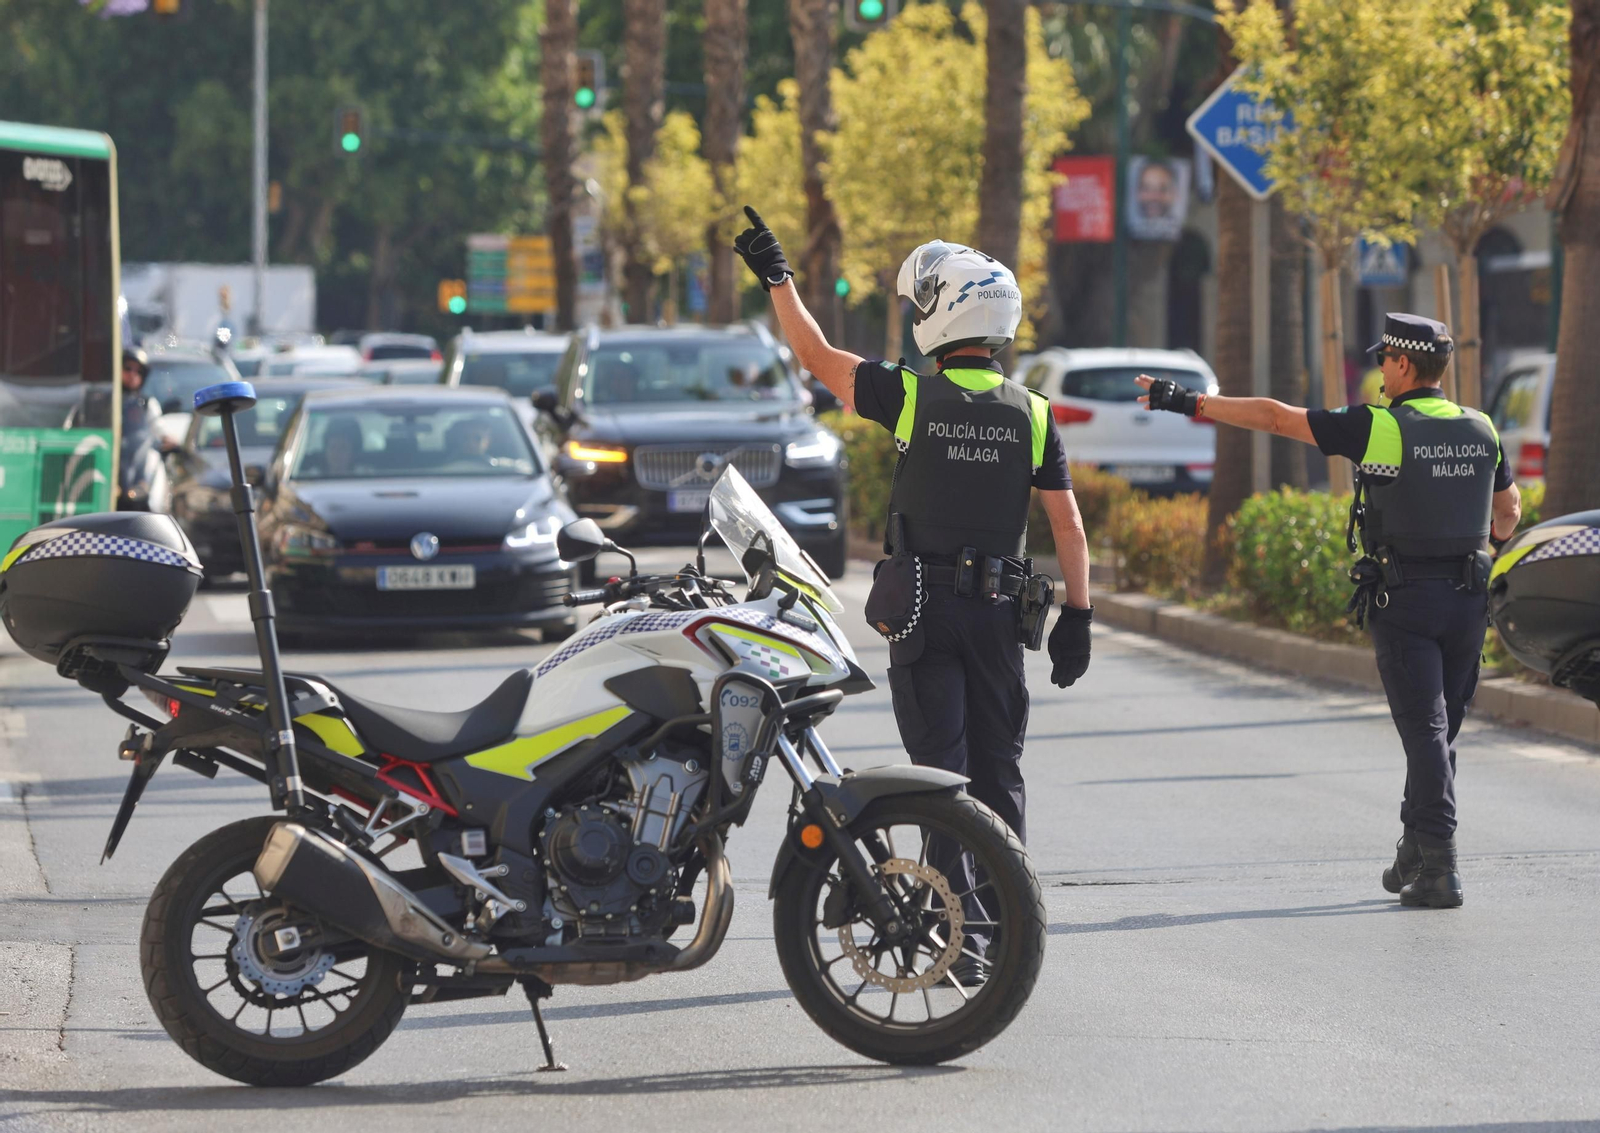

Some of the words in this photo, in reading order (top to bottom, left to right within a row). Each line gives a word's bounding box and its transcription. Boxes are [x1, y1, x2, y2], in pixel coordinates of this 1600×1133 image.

[977, 287, 1007, 300] POLICÍA
[928, 421, 977, 440] POLICÍA
[979, 426, 1020, 443] LOCAL
[947, 443, 1000, 463] MÁLAGA
[1413, 442, 1454, 459] POLICÍA
[1455, 444, 1489, 458] LOCAL
[1432, 461, 1475, 478] MÁLAGA
[729, 695, 759, 708] 092
